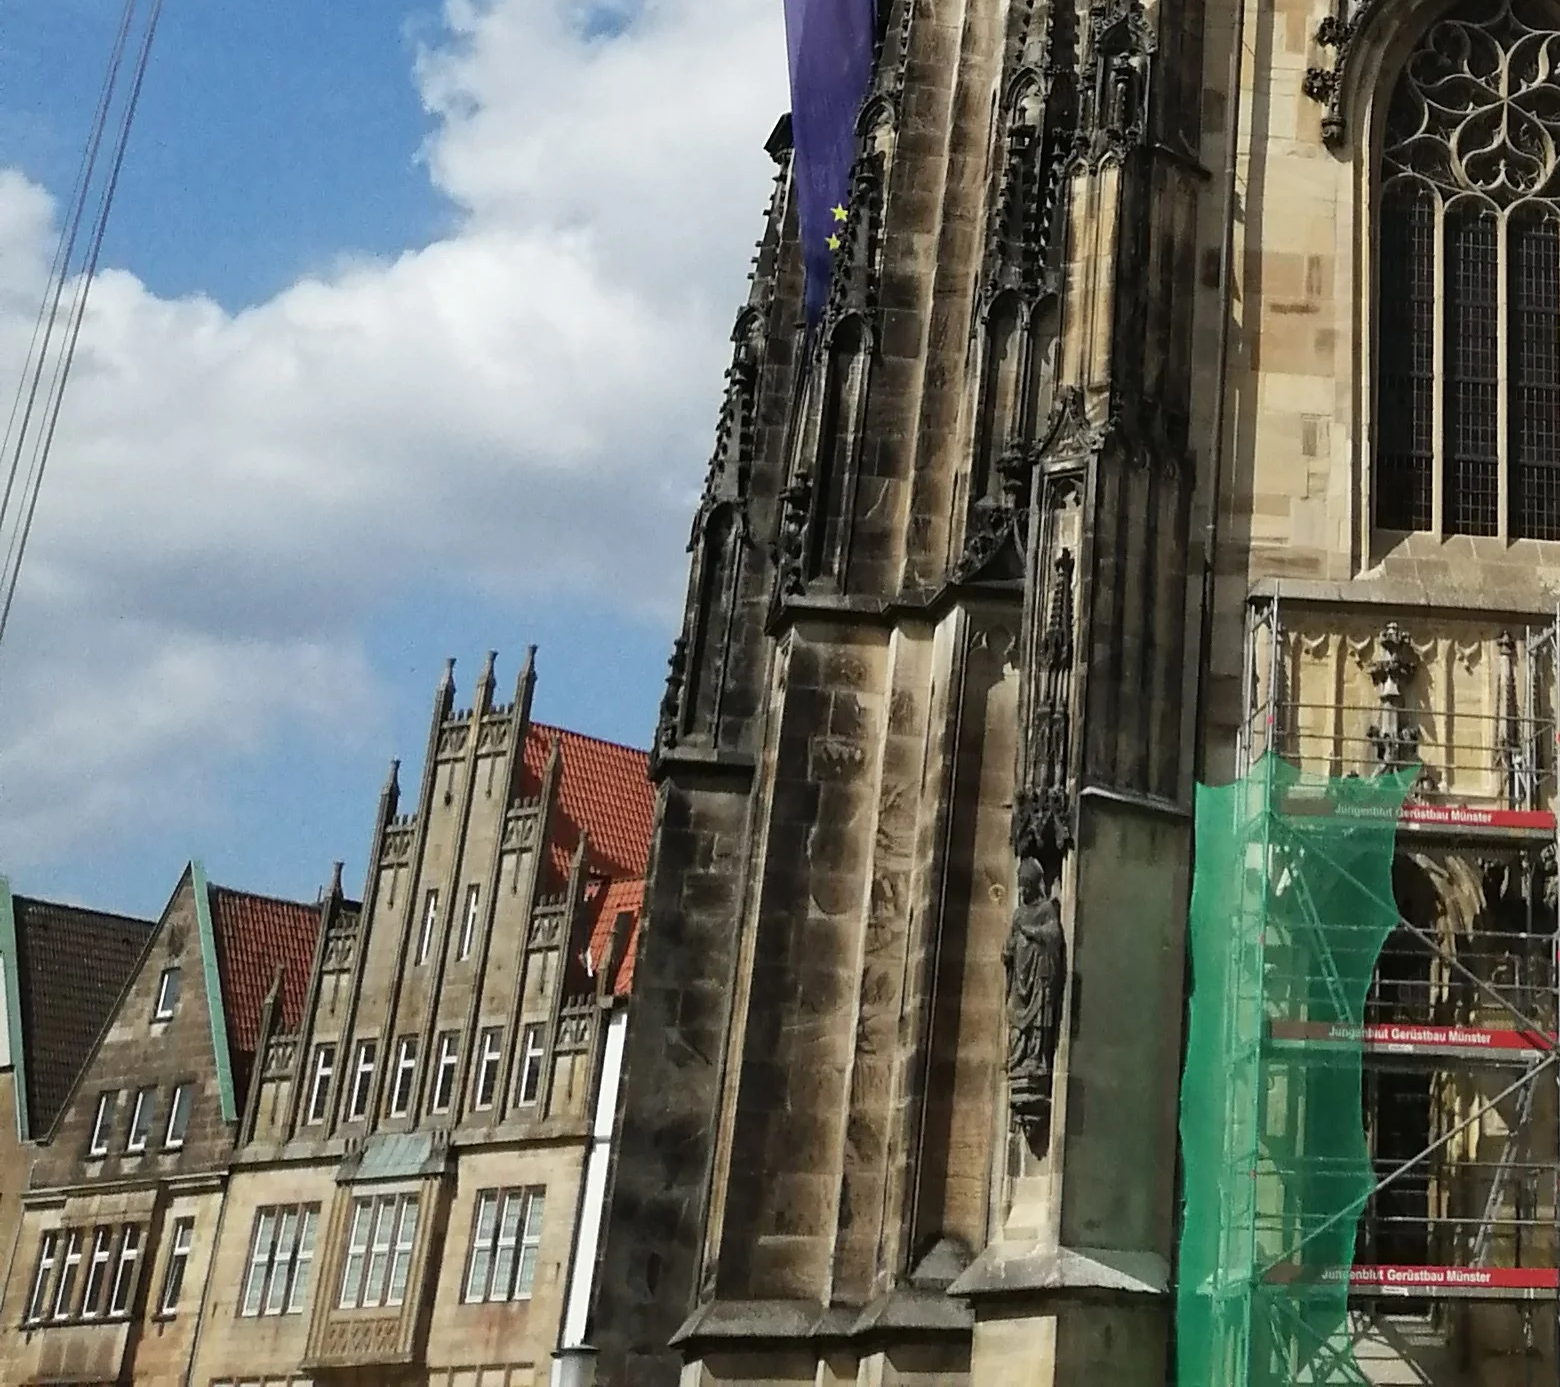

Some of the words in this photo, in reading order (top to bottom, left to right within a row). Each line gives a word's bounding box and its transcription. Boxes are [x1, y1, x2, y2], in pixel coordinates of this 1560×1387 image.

[1396, 807, 1448, 821] Gerüstbau
[1451, 809, 1492, 823] Münster
[1391, 1027, 1446, 1042] Gerüstbau
[1449, 1029, 1491, 1044] Münster
[1387, 1268, 1445, 1282] Gerüstbau
[1446, 1270, 1491, 1283] Münster
